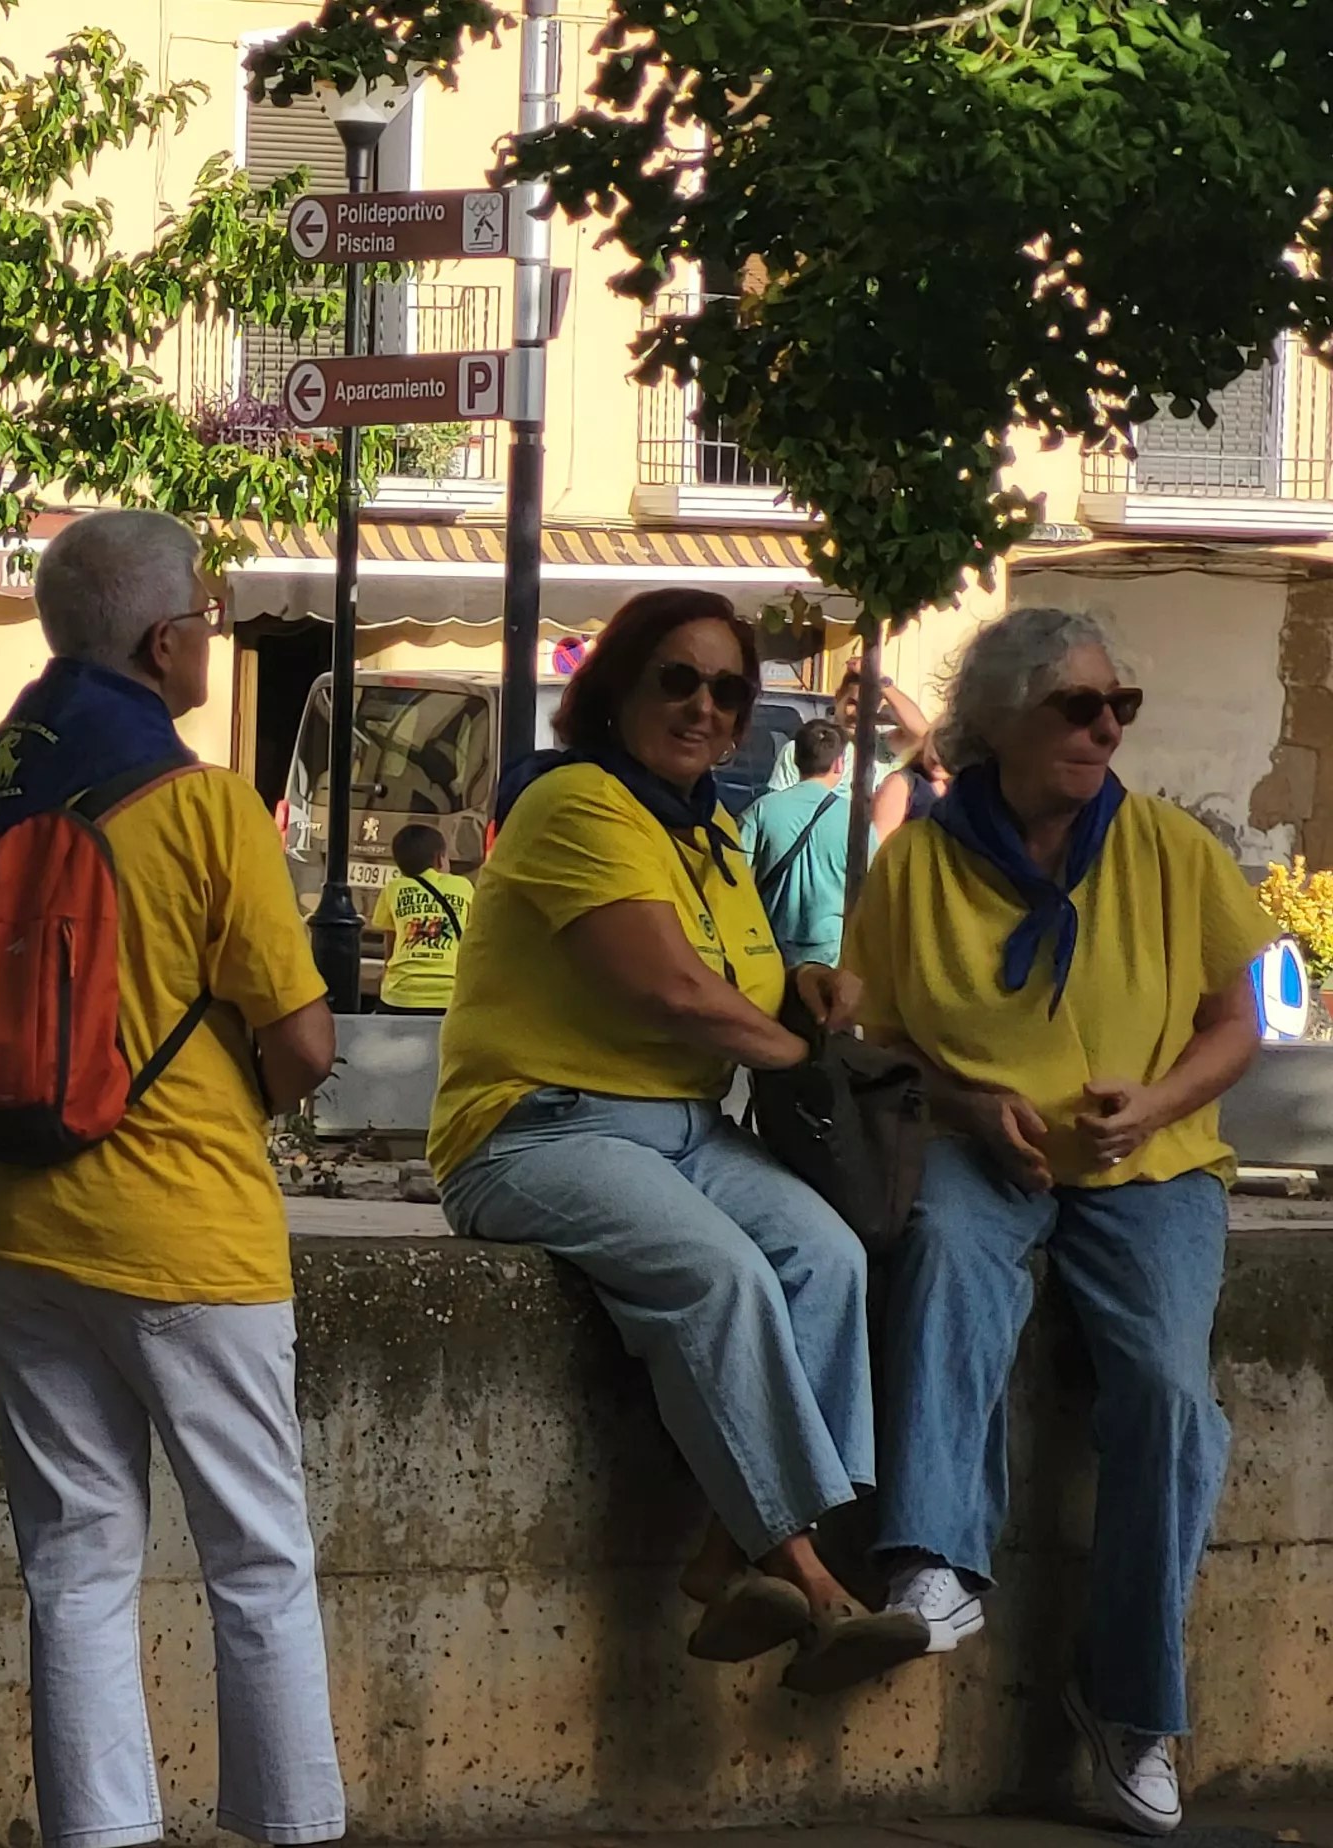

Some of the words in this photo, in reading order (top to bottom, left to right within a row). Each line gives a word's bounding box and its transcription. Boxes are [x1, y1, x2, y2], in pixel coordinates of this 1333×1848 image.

[337, 201, 445, 227] Polideportivo
[337, 231, 395, 254] Piscina
[334, 378, 446, 407] Aparcamiento
[467, 362, 492, 410] P
